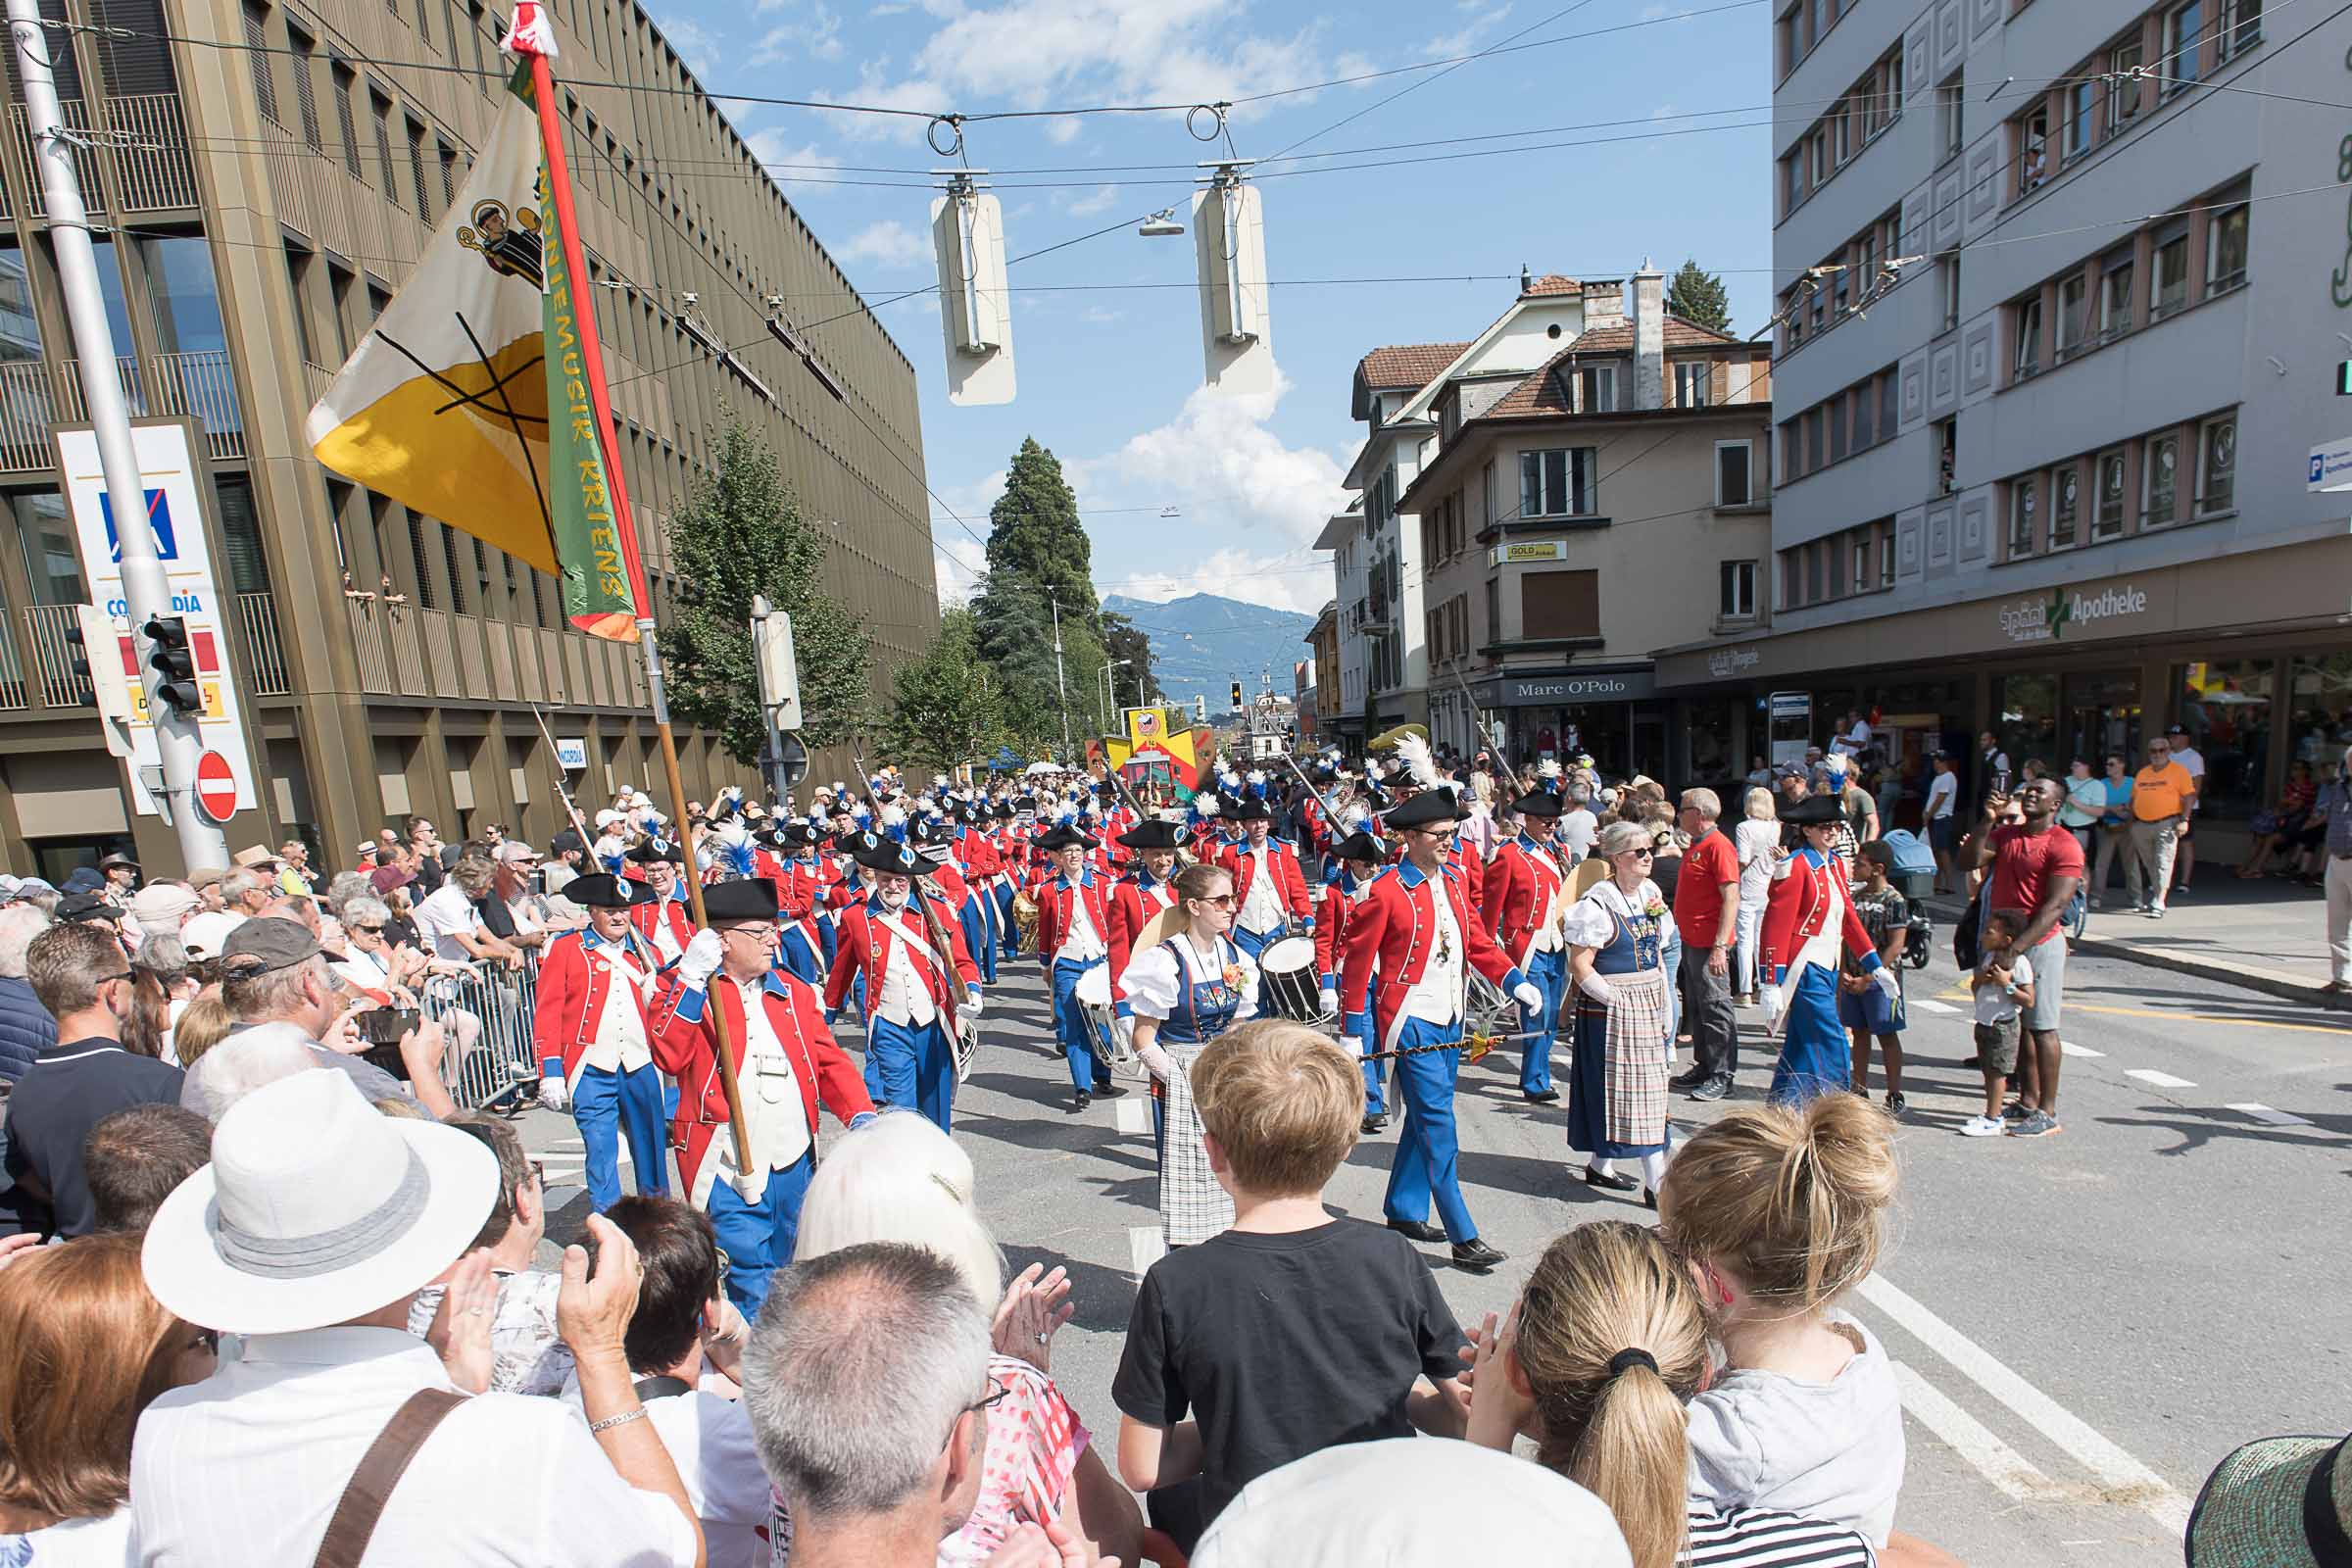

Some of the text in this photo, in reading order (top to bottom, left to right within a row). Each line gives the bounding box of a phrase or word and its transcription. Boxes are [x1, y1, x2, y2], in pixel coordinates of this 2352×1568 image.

[540, 141, 625, 598] MONIEMUSIK KRIENS
[2312, 459, 2322, 477] P
[107, 588, 202, 616] CODIA
[2072, 585, 2146, 624] Apotheke
[1517, 679, 1626, 697] Marc O'Polo
